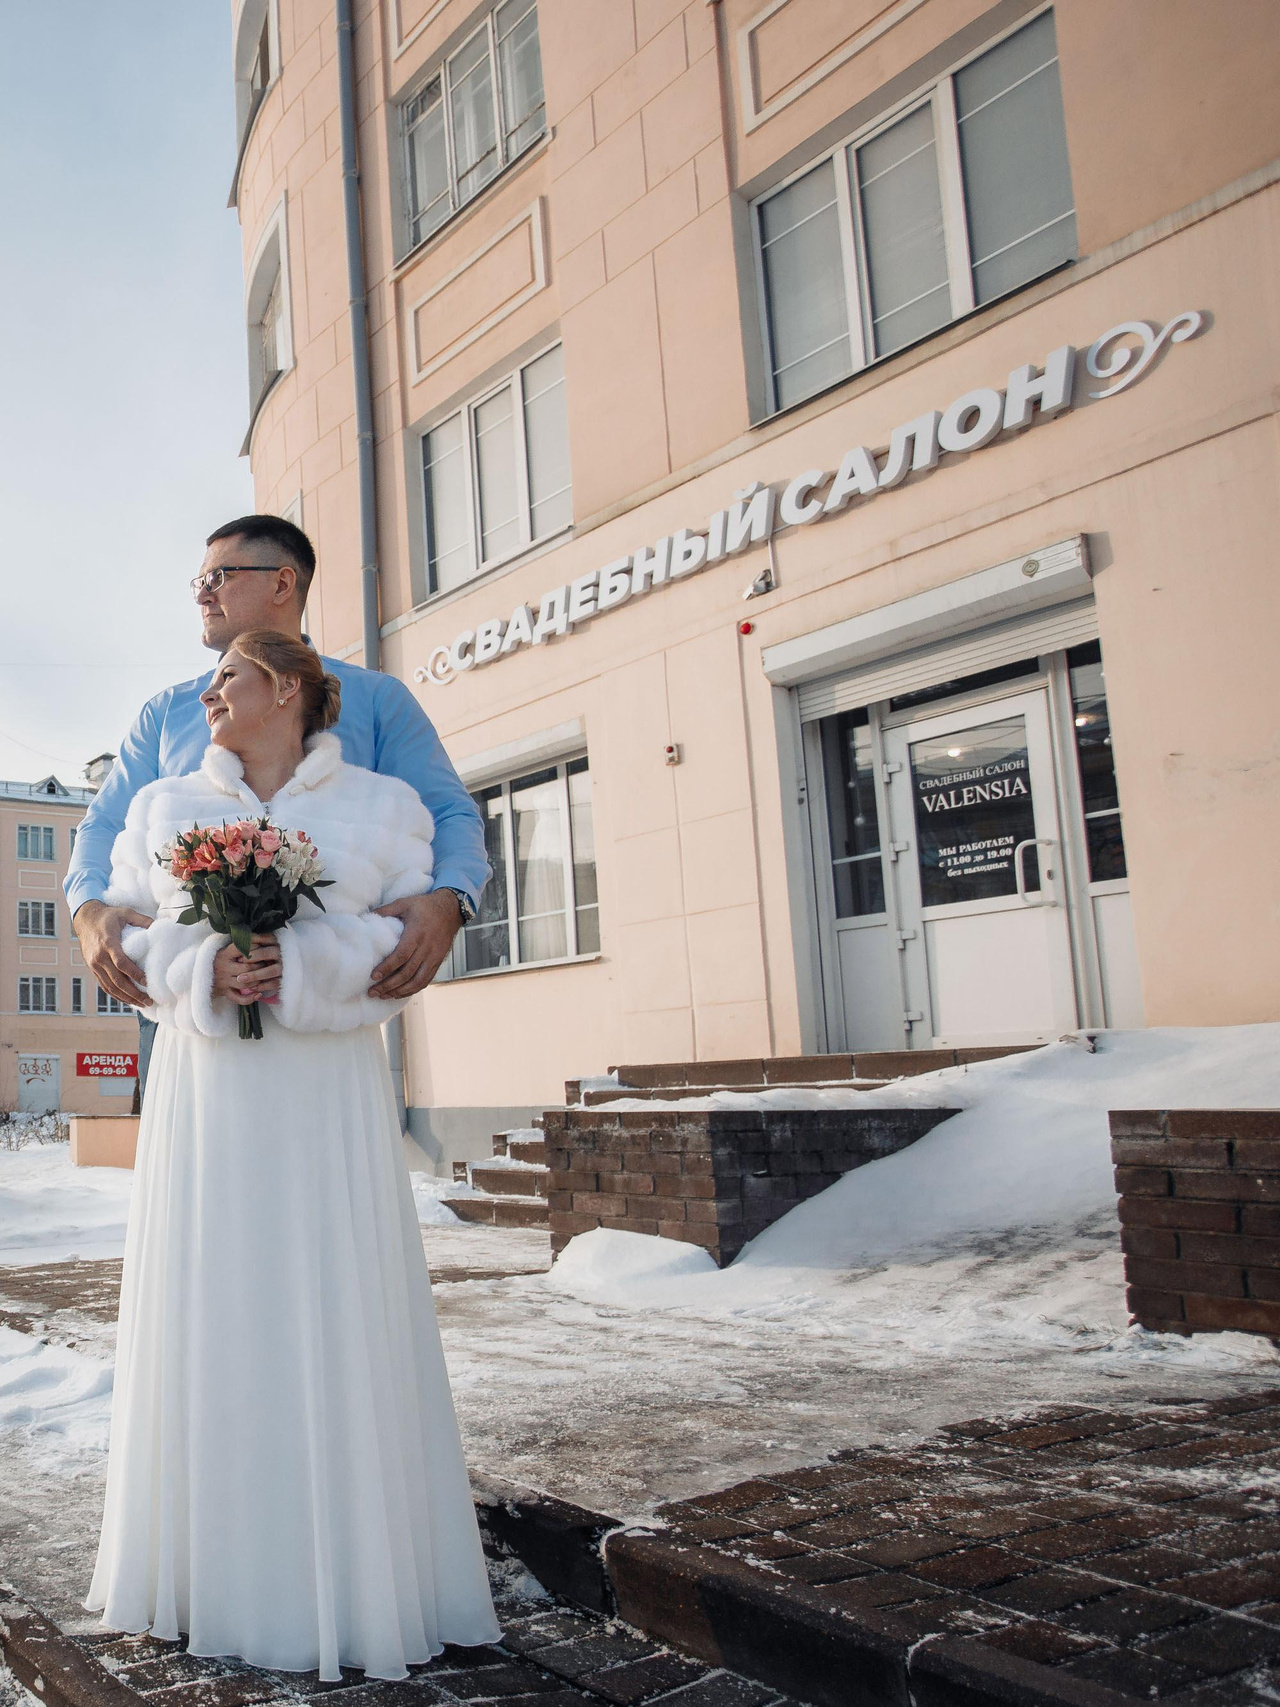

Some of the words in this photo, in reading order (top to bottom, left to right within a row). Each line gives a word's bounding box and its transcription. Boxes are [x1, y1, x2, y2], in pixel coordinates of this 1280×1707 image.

[449, 481, 776, 672] СВАДЕБНЫЙ
[780, 345, 1075, 525] САЛОН
[919, 766, 984, 790] СВАДЕБНЫЙ
[985, 759, 1026, 776] САЛОН
[921, 776, 1028, 813] VALENSIA
[938, 847, 956, 858] МЫ
[959, 835, 1014, 853] РАБОТАЕМ
[947, 855, 972, 867] 11.00
[972, 853, 985, 863] до
[986, 847, 1013, 860] 19.00
[947, 867, 962, 878] без
[963, 861, 1009, 876] выходных
[82, 1055, 133, 1067] АРЕНДА
[88, 1067, 127, 1075] 69-69-60
